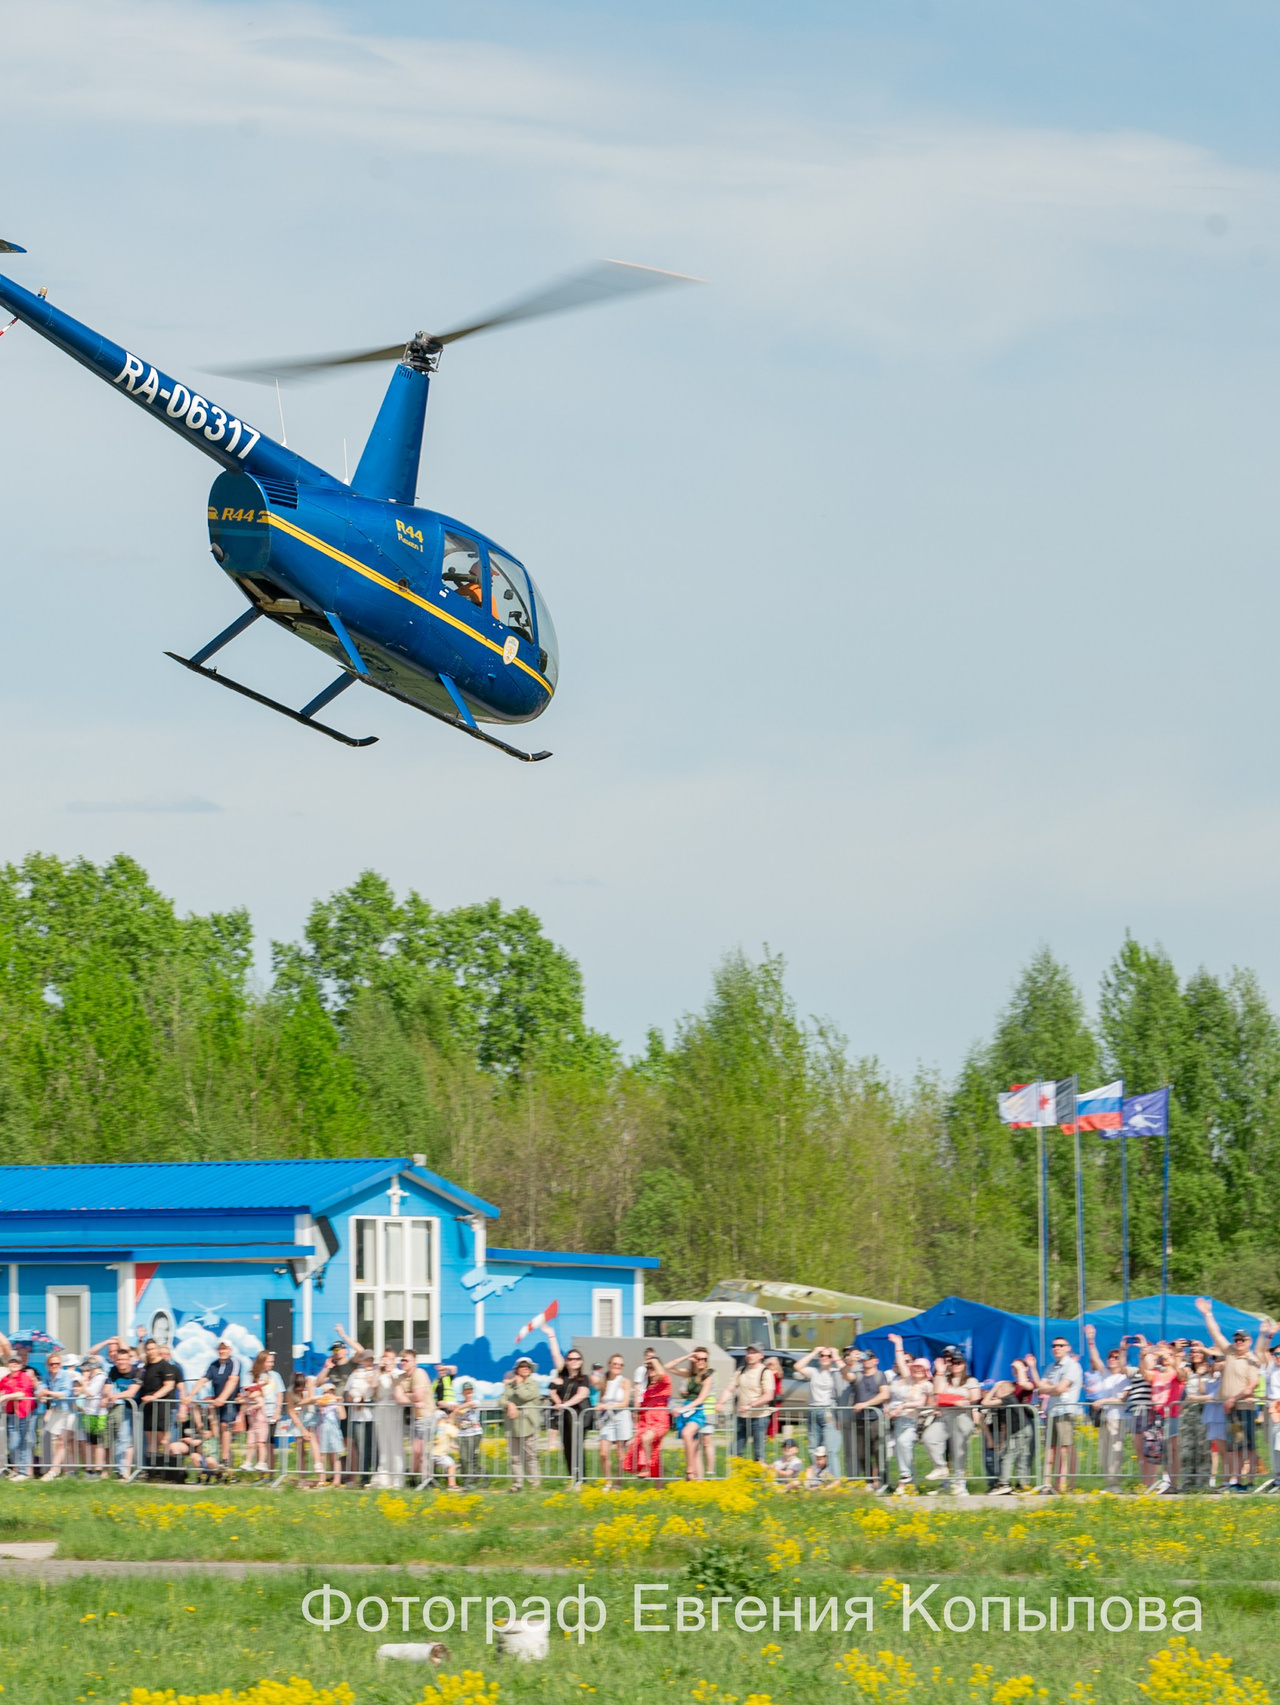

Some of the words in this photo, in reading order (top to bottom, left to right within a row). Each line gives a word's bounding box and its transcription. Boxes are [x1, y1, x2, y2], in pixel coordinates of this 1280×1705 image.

[112, 351, 261, 460] RA-06317
[221, 507, 255, 523] R44
[395, 518, 424, 544] R44
